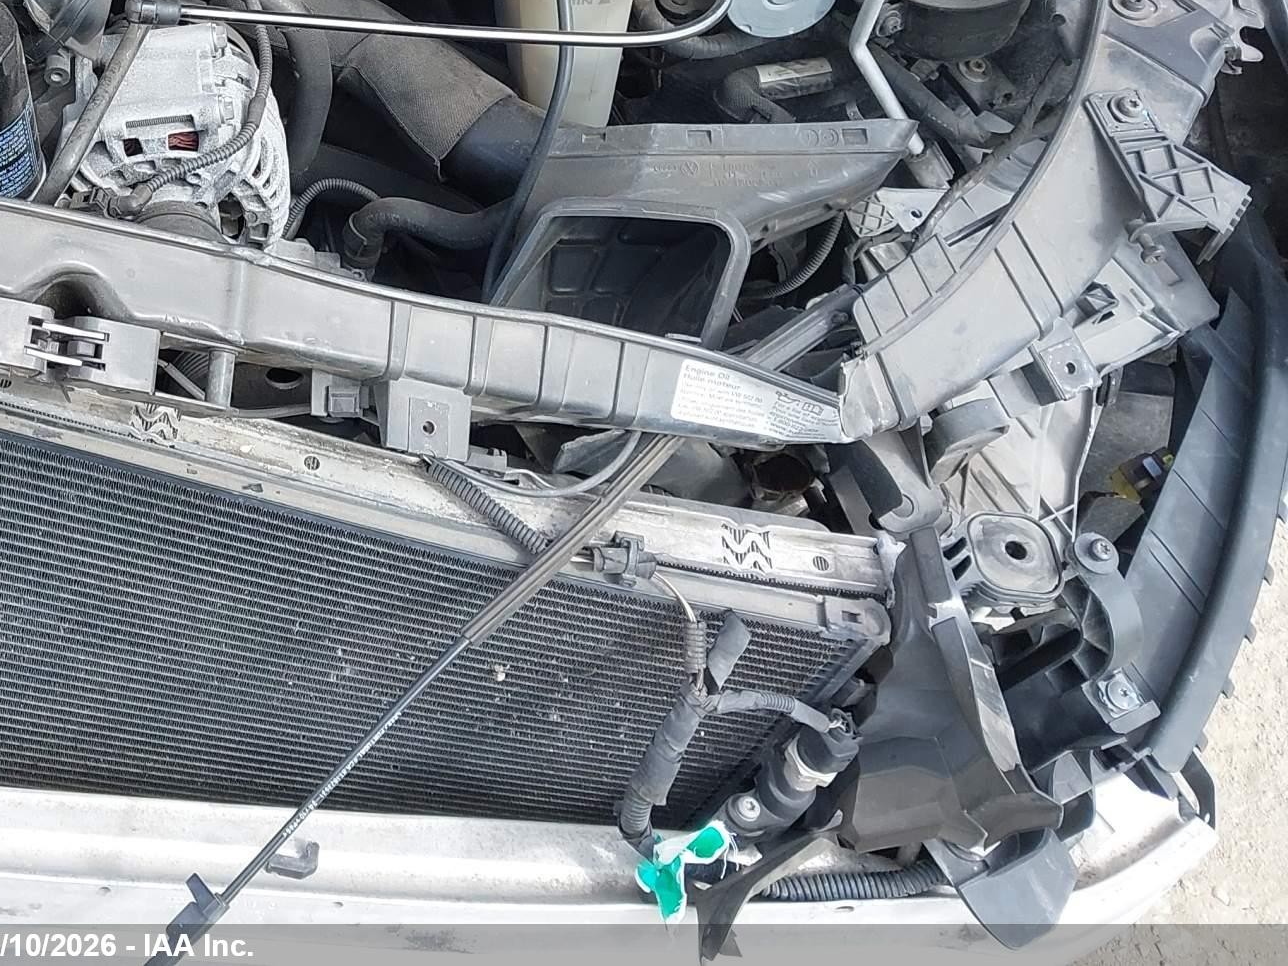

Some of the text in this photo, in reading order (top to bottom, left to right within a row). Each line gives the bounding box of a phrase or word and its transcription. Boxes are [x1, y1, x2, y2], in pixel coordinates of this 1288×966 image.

[685, 364, 730, 381] Engine Oil
[683, 373, 706, 383] Huile
[707, 379, 741, 390] moteur
